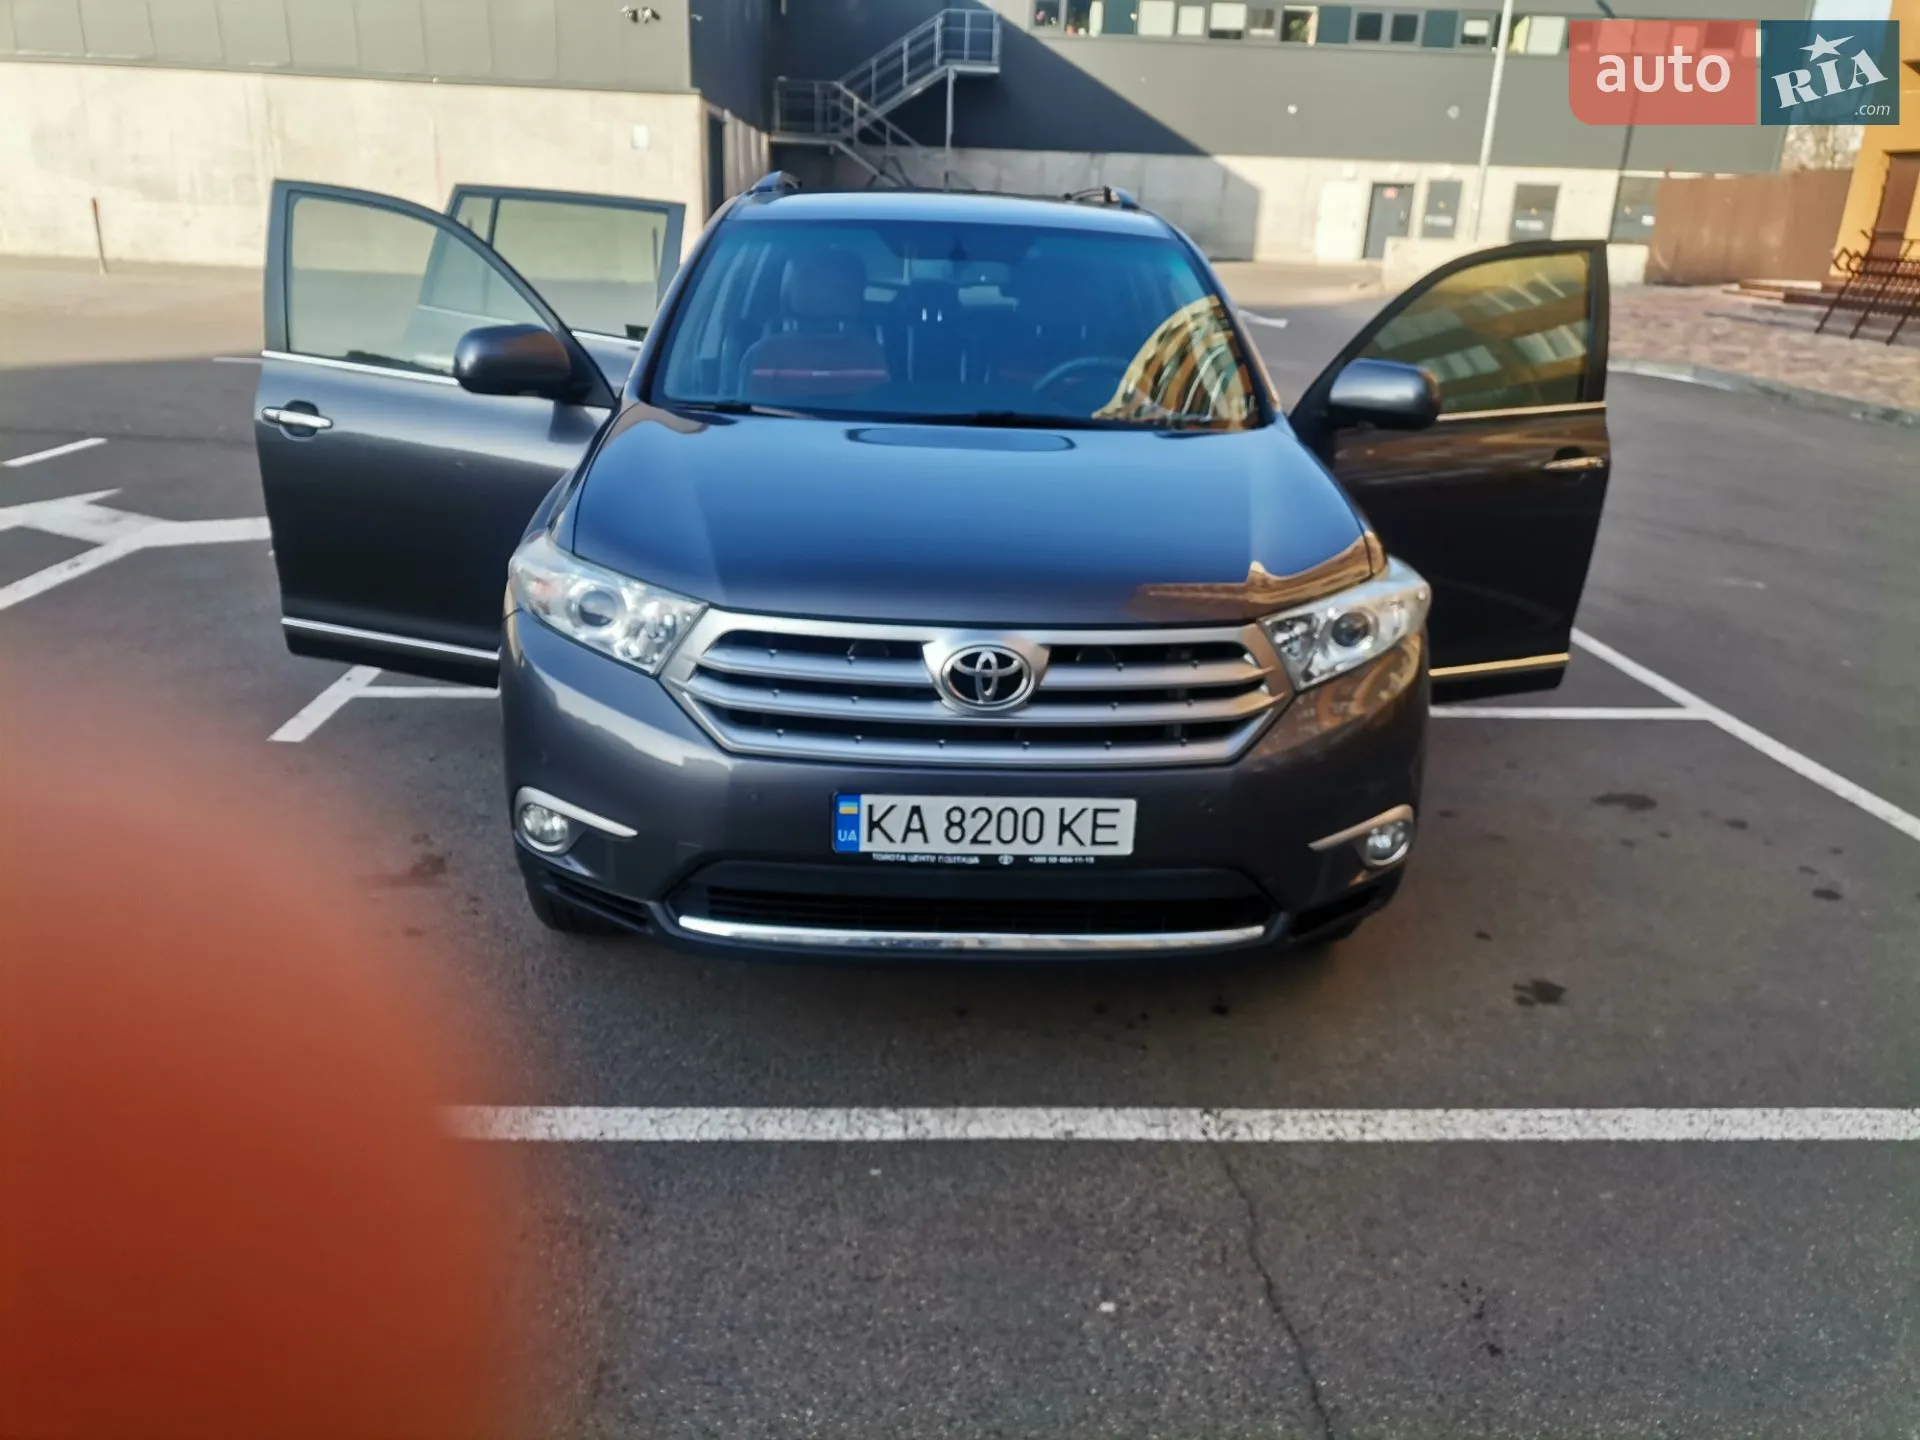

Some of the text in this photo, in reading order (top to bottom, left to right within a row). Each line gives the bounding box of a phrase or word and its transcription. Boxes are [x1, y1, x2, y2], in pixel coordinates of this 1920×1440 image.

[837, 829, 857, 842] UA
[867, 804, 1121, 847] KA 8200 KE
